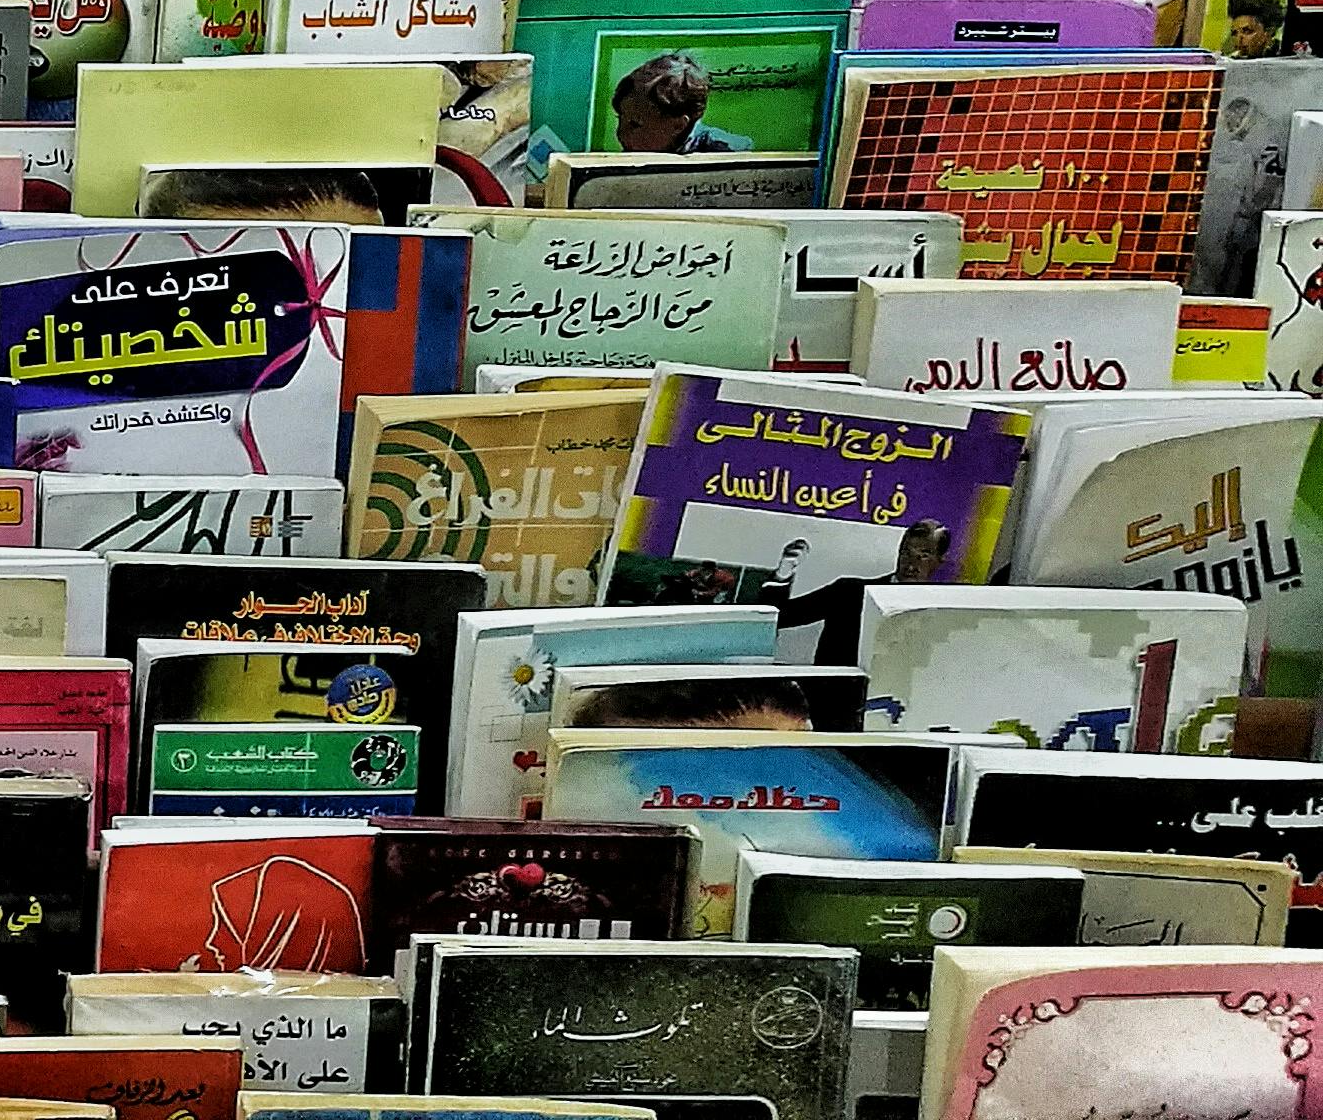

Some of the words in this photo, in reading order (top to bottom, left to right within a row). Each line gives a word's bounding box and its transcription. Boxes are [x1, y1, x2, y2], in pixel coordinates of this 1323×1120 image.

[71, 276, 140, 305] على
[146, 265, 230, 301] تعرف
[8, 292, 268, 385] شخصيتك
[8, 898, 42, 938] في
